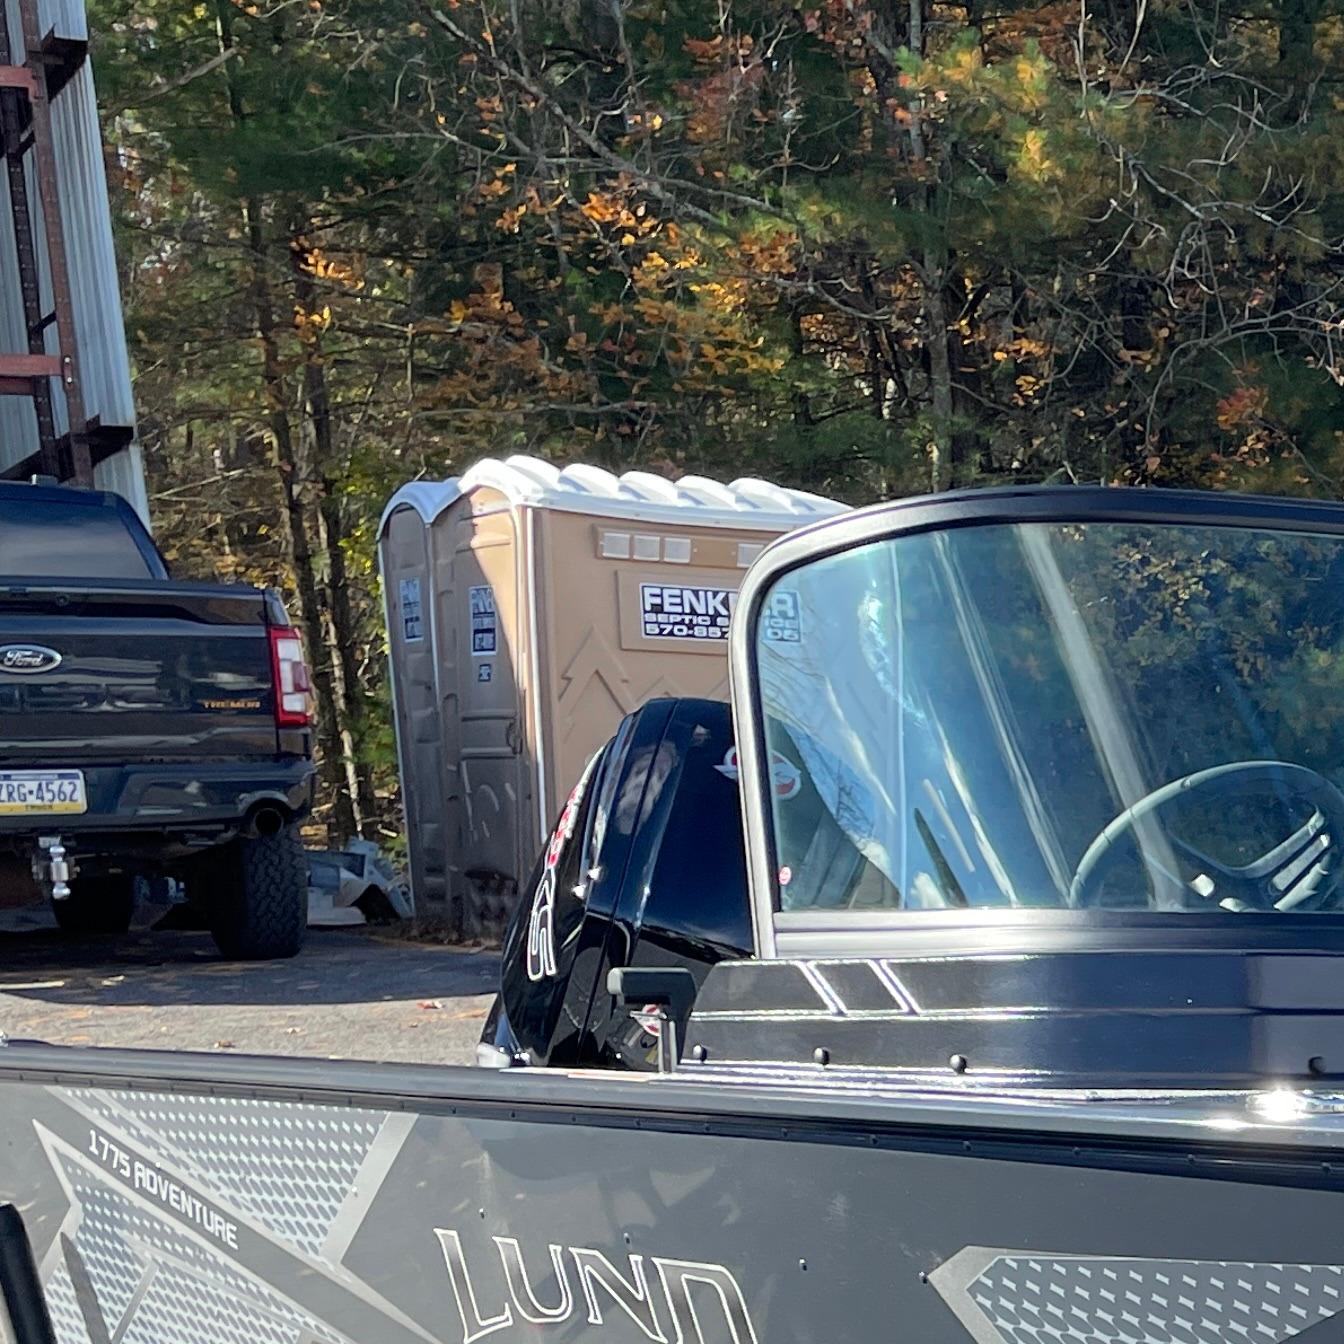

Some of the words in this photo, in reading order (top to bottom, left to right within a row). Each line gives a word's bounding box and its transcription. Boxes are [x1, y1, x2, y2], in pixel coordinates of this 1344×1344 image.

[644, 613, 711, 626] SEPTIC
[3, 650, 46, 667] Ford
[88, 1129, 131, 1178] 1775
[133, 1160, 239, 1250] ADVENTURE
